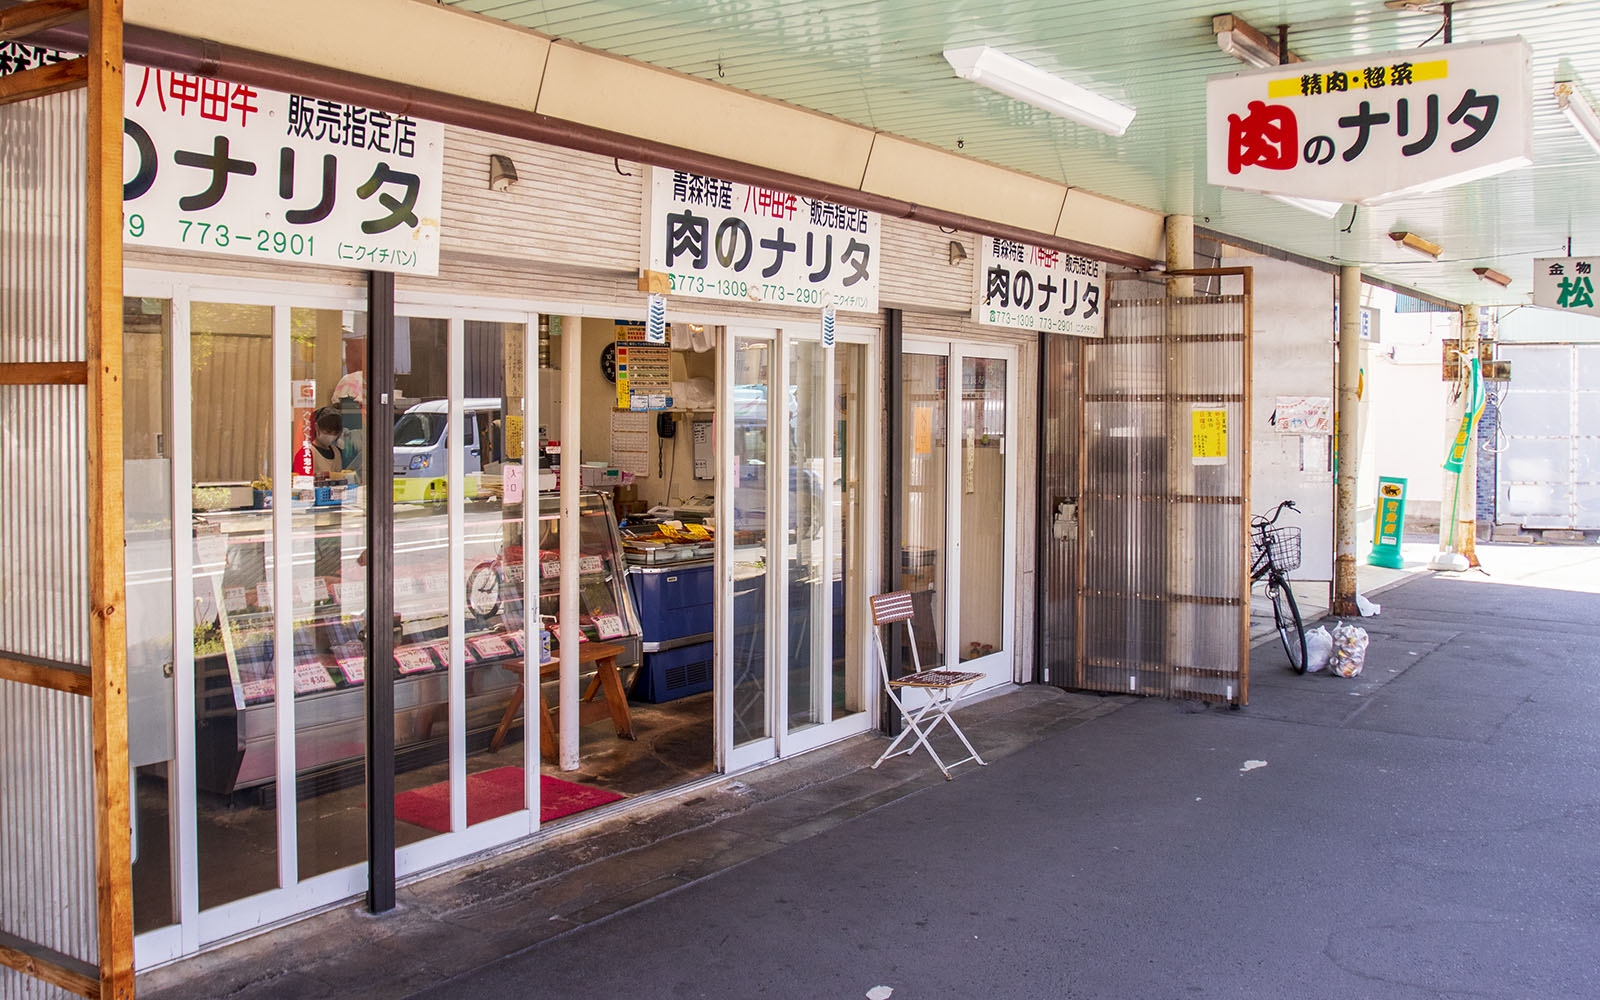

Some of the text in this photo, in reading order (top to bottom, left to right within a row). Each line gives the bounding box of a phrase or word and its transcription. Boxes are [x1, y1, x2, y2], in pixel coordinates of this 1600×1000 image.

[1301, 62, 1414, 97] 精肉・惣菜
[136, 67, 259, 127] 八甲田牛
[287, 94, 417, 158] 販売指定店
[1228, 89, 1499, 175] 肉のナリタ
[672, 171, 868, 233] 青森特産 八甲田牛 販売指定店
[179, 220, 315, 256] 773-2901
[666, 209, 871, 287] 肉のナリタ
[1549, 261, 1592, 276] 金物
[678, 275, 748, 297] 773-1309
[762, 285, 823, 304] 773-2901
[987, 264, 1100, 320] 肉のナリタ
[1557, 276, 1595, 308] 松
[510, 468, 518, 493] 入口
[1384, 501, 1399, 534] 宅急便
